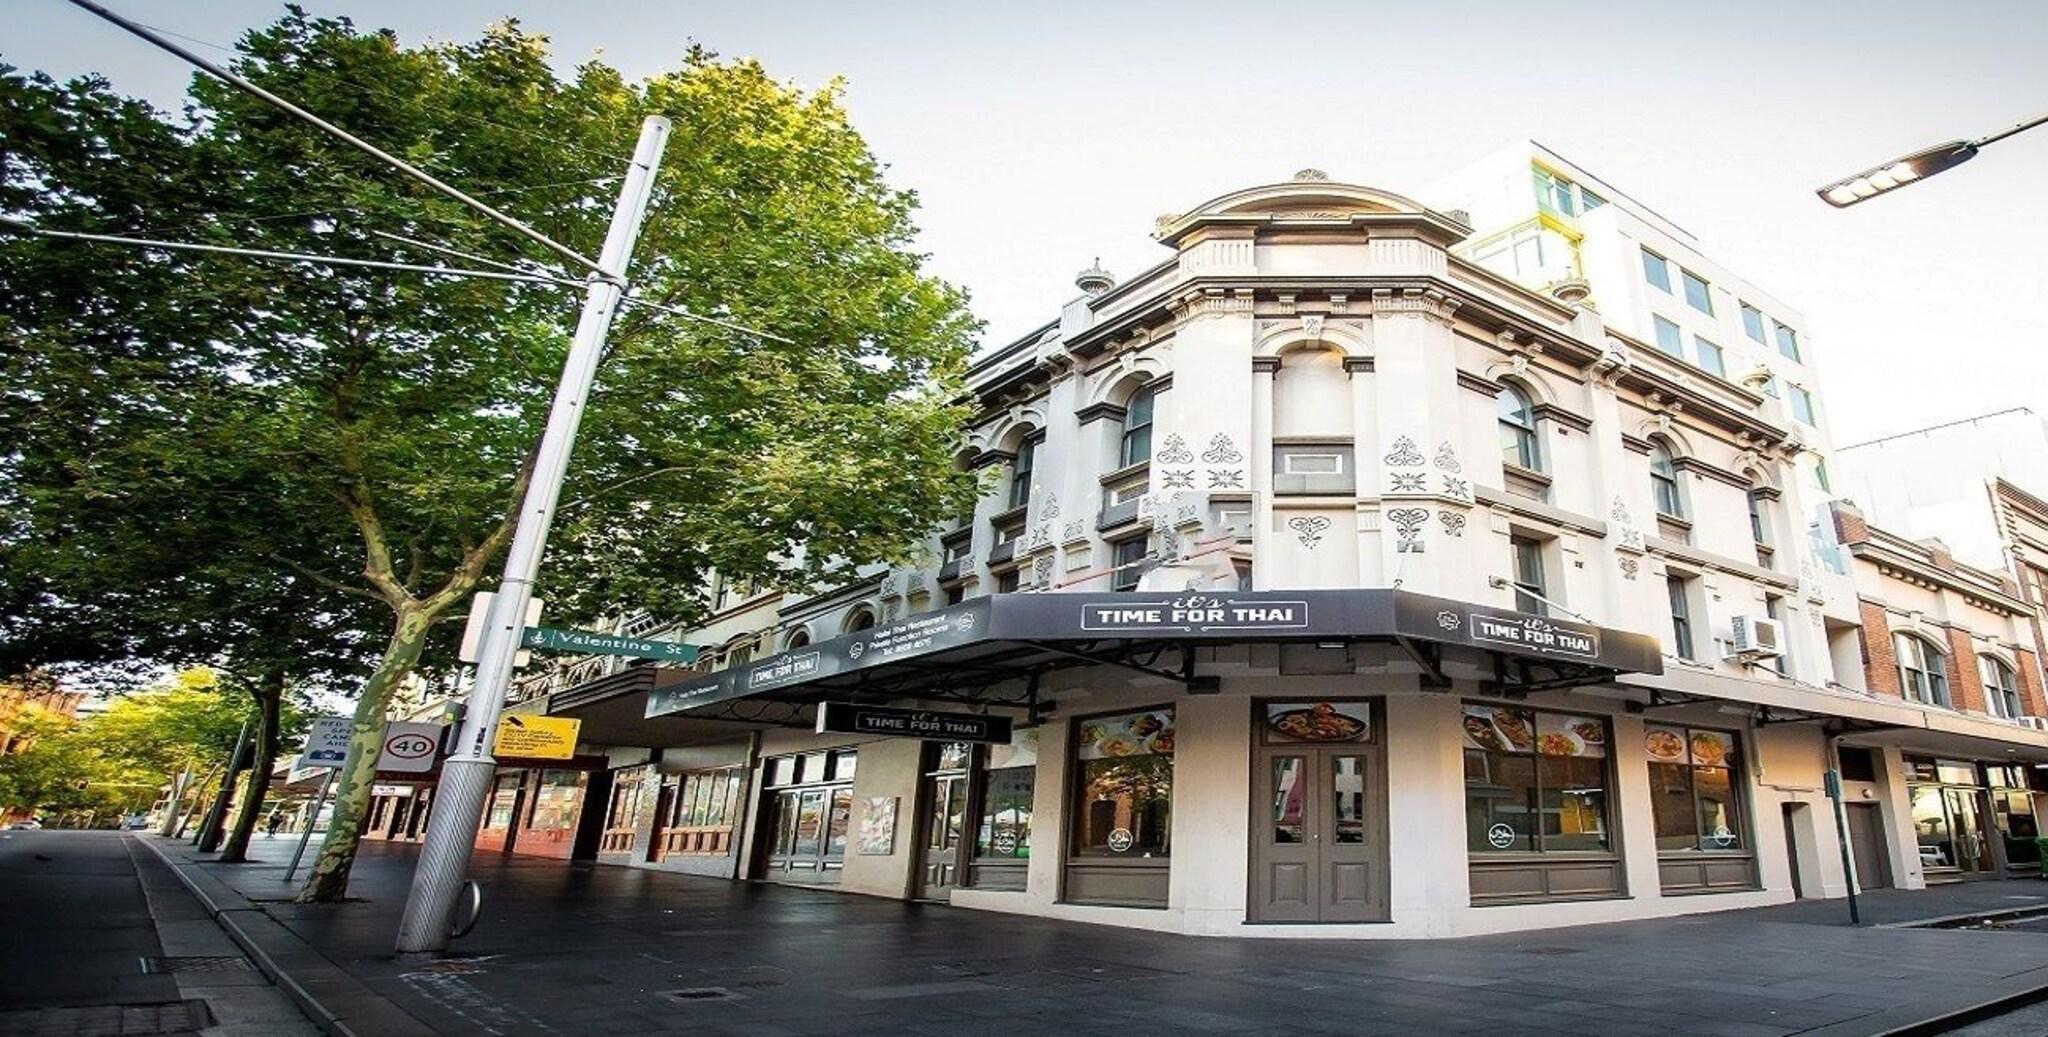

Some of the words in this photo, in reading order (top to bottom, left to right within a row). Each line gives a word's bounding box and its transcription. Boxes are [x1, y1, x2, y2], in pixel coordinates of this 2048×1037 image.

[1171, 596, 1225, 609] it's
[1097, 610, 1161, 623] TIME
[1171, 609, 1225, 622] FOR
[1232, 608, 1293, 621] THAI
[559, 632, 652, 651] Valentine
[666, 643, 682, 655] St
[1480, 622, 1519, 639] TIME
[1524, 629, 1555, 645] FOR
[1558, 635, 1591, 651] THAI
[755, 668, 773, 682] TIME
[775, 664, 792, 677] FOR
[793, 658, 814, 673] THAI
[865, 717, 905, 729] TIME
[910, 720, 941, 731] FOR
[944, 722, 977, 733] THAI
[394, 741, 427, 752] 40
